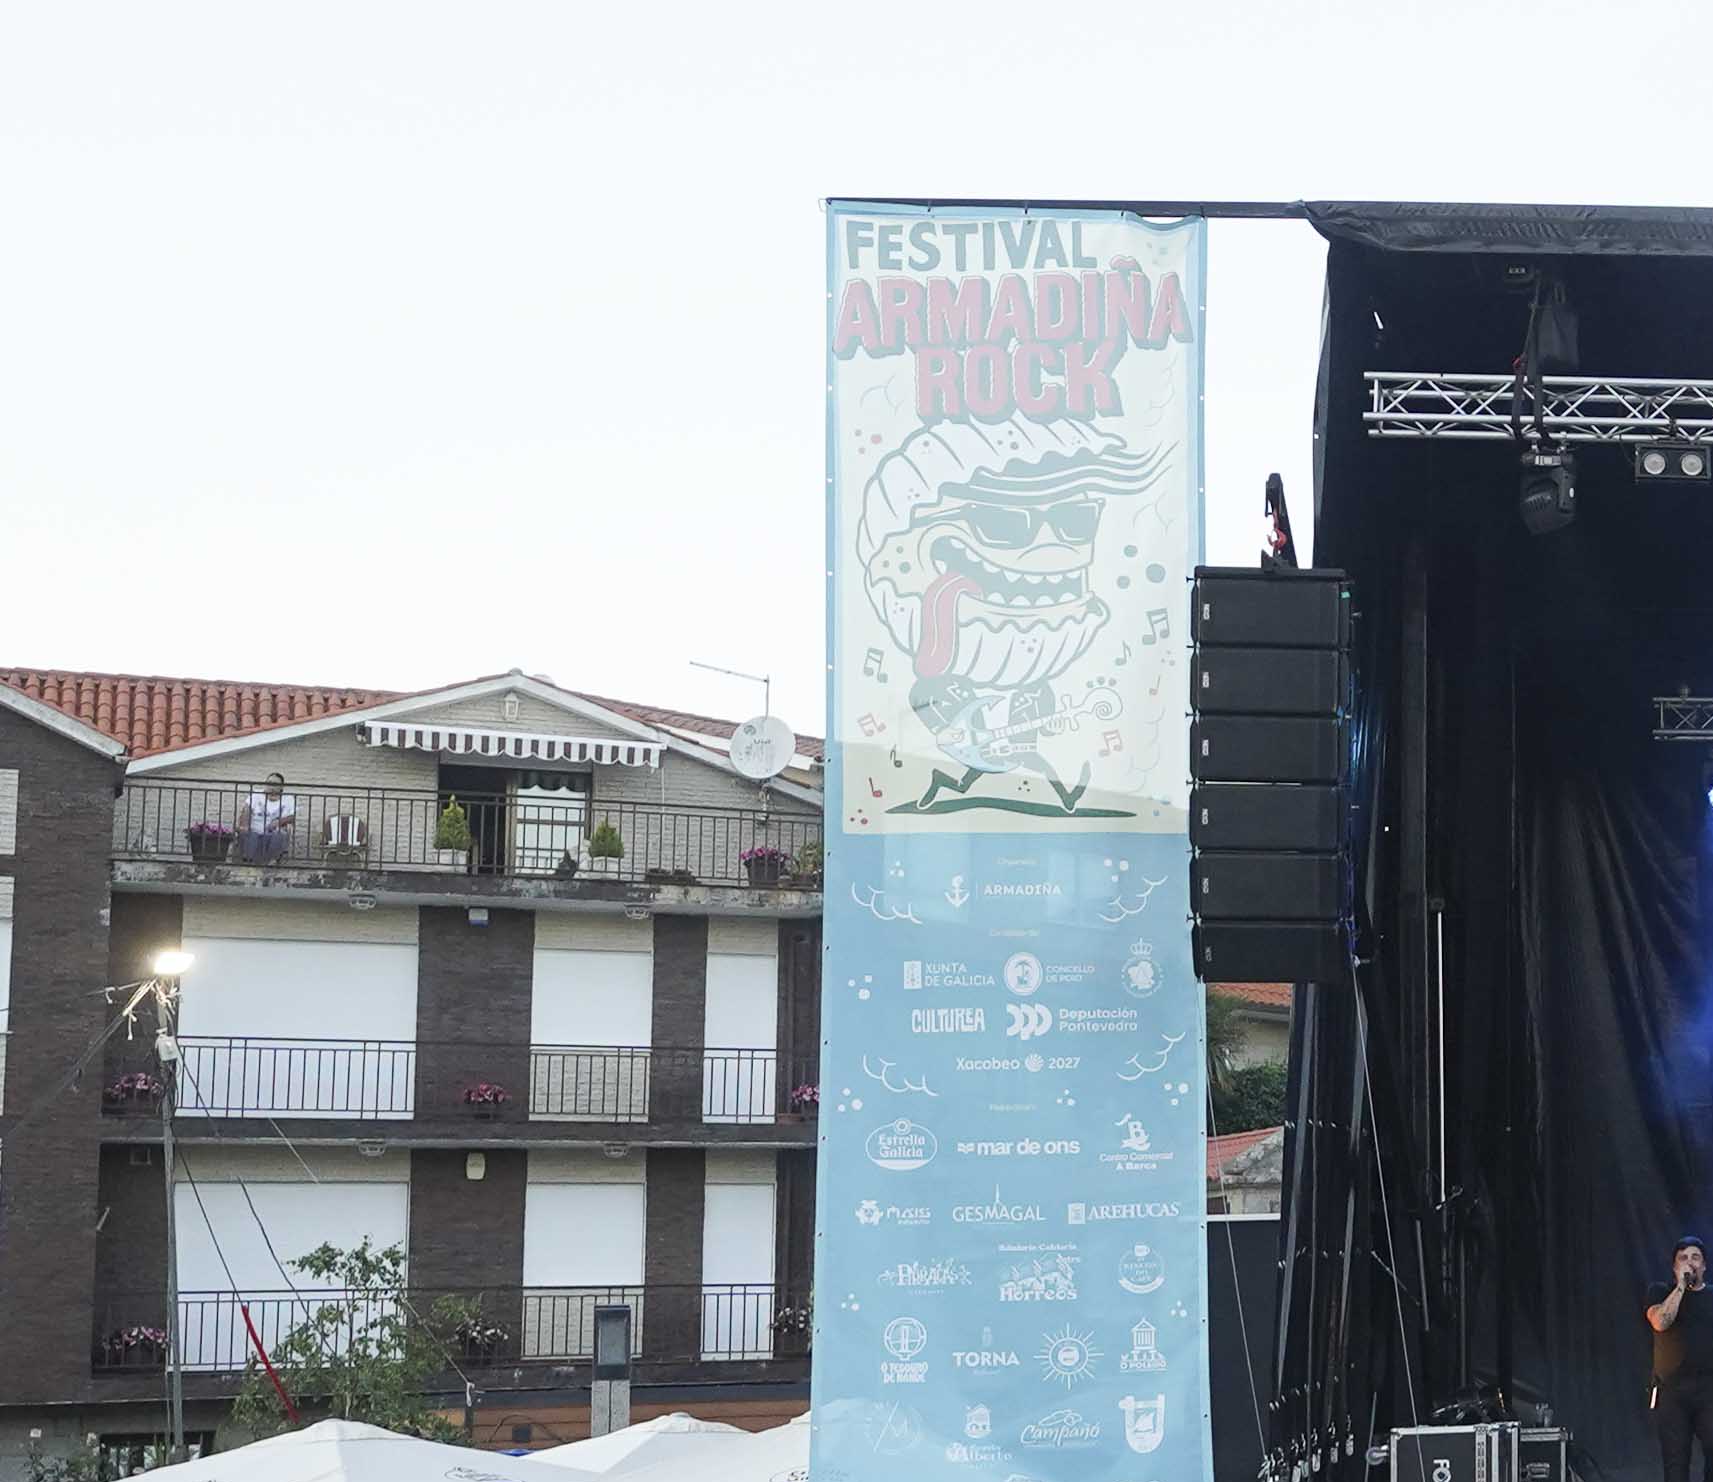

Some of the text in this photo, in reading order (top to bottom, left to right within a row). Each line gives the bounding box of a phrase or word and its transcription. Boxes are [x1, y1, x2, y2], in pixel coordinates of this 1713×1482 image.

[846, 221, 1097, 272] FESTIVAL
[832, 255, 1194, 360] ARMADIÑA
[916, 340, 1124, 423] ROCK
[984, 881, 1063, 896] ARMADIÑA
[926, 963, 967, 974] XUNTA
[925, 975, 995, 987] DE GALICIA
[1059, 1007, 1138, 1022] Deputación
[1059, 1020, 1138, 1033] Pontevedra
[956, 1056, 1081, 1070] Xacobeo 2027
[878, 1133, 925, 1147] Estrella
[977, 1138, 1081, 1155] mar de ons
[879, 1145, 923, 1159] Galicia
[952, 1201, 1047, 1223] GESMAGAL
[1087, 1201, 1181, 1221] AREHUCAS
[952, 1351, 1021, 1368] TORNA
